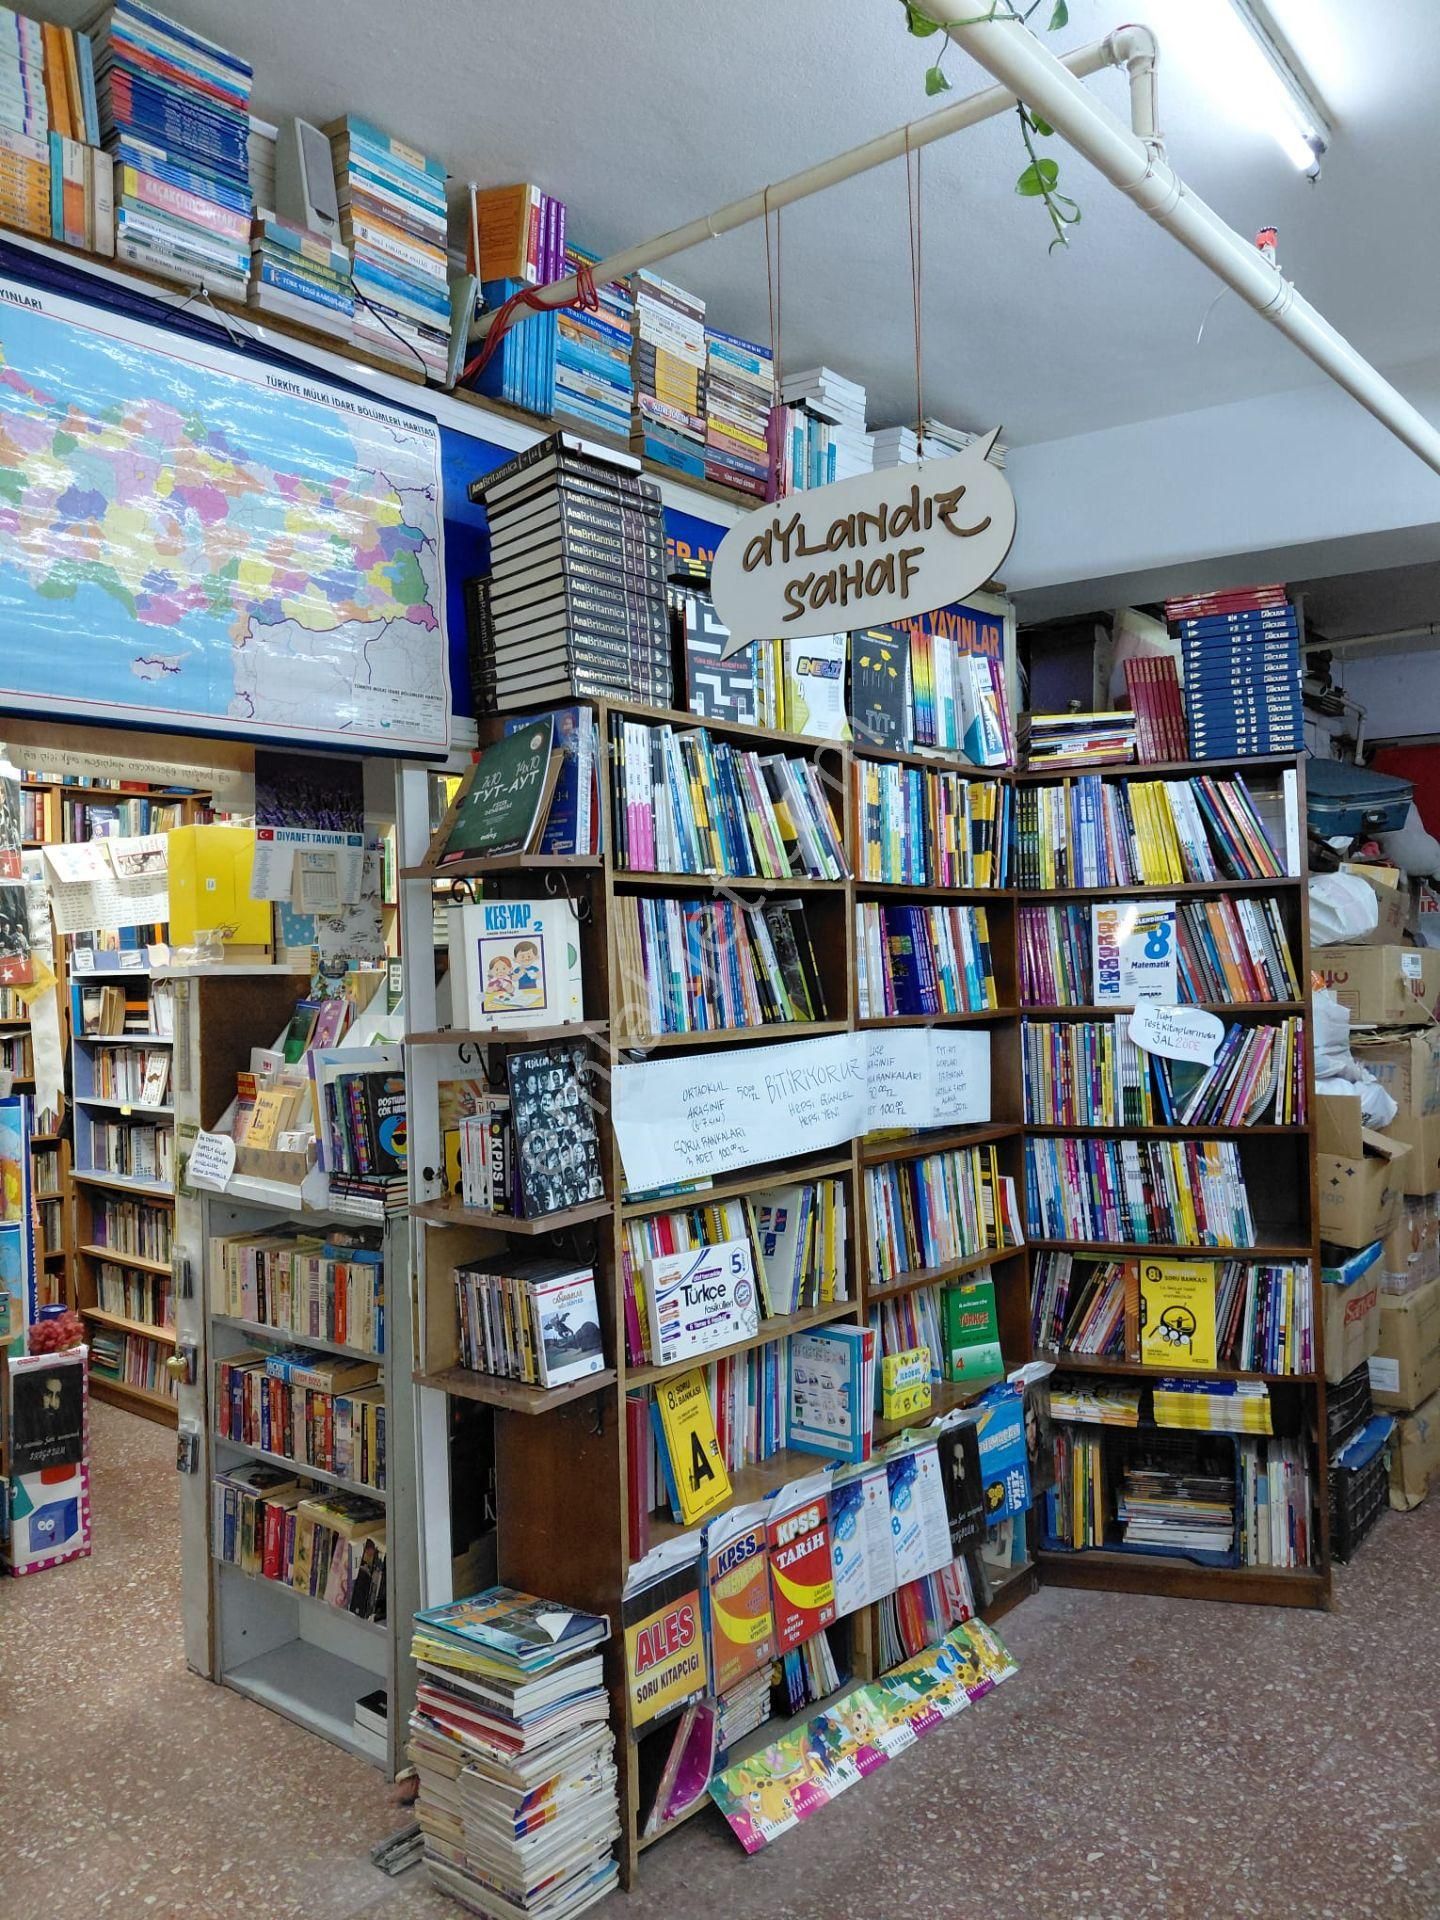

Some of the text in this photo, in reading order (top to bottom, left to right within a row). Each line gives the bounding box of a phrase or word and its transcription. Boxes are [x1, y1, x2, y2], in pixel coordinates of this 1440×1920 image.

[265, 374, 301, 395] TÜRKİYE
[567, 490, 621, 516] AnaBritannica
[567, 506, 621, 532] AnaBritannica
[568, 525, 621, 549] AnaBritannica
[569, 541, 622, 564] AnaBritannica
[570, 560, 623, 583] AnaBritannica
[571, 580, 624, 602] AnaBritannica
[572, 597, 626, 619] AnaBritannica
[573, 615, 627, 636] AnaBritannica
[574, 632, 628, 654] AnaBritannica
[575, 650, 628, 670] AnaBritannica
[575, 666, 628, 687] AnaBritannica
[579, 683, 630, 702] AnaBritannica
[473, 769, 541, 805] TYT-AYT
[533, 920, 543, 932] 2
[1144, 922, 1172, 960] 8
[1131, 960, 1171, 970] Matematik
[1143, 1018, 1161, 1030] Test
[1152, 1031, 1161, 1044] 3
[1161, 1034, 1174, 1047] AL
[492, 1137, 504, 1182] KPDS
[680, 1283, 728, 1308] Türkçe
[675, 1380, 691, 1394] SORU
[678, 1387, 702, 1406] BANKASI
[1010, 1470, 1023, 1511] ZEKA
[775, 1505, 822, 1548] KPSS
[891, 1515, 901, 1536] 8
[717, 1532, 758, 1579] KPSS
[776, 1530, 826, 1571] TARİH
[833, 1546, 844, 1566] 8
[634, 1603, 697, 1678] ALES
[636, 1678, 660, 1705] SORU
